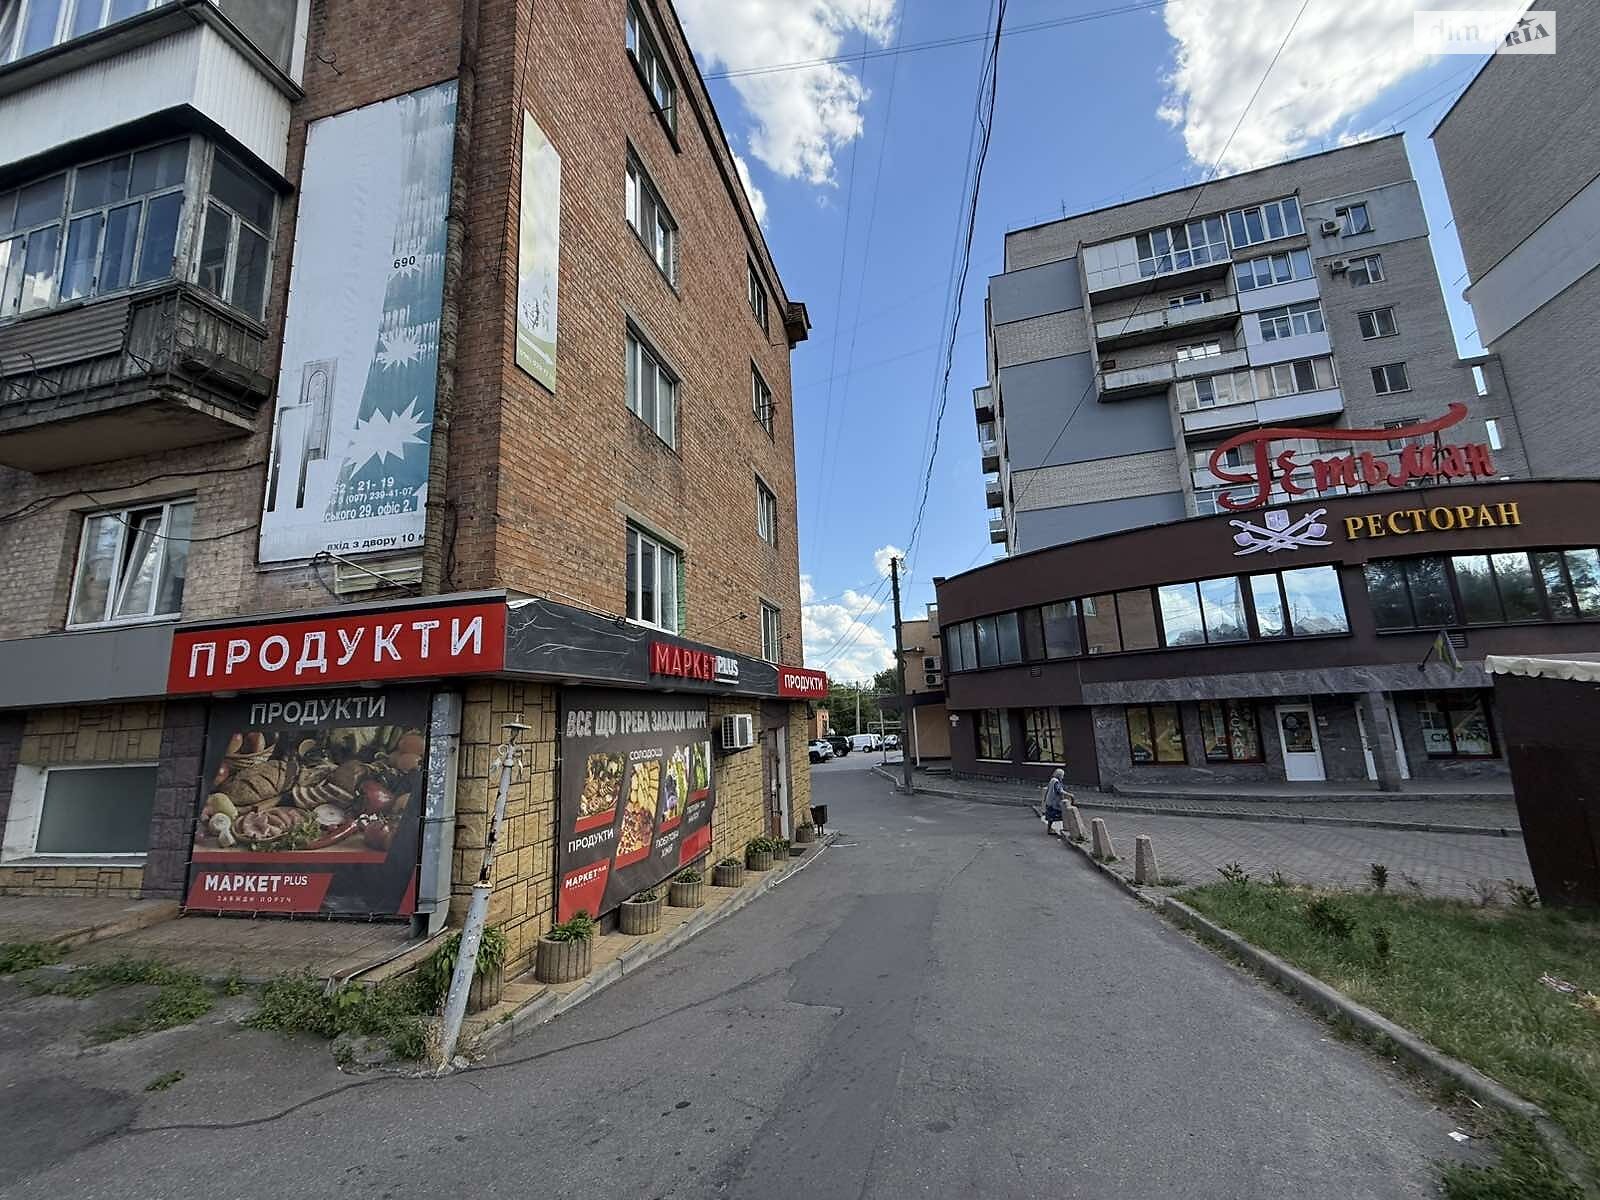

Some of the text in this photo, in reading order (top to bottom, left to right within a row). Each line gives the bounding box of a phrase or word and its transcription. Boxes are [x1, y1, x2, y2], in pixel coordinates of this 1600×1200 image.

[393, 255, 416, 269] 690
[1343, 502, 1522, 540] РЕСТОРАН
[362, 536, 397, 549] двору
[402, 532, 414, 543] 10
[188, 616, 483, 678] ПРОДУКТИ
[653, 643, 739, 682] МАРКЕТ PLUS
[784, 674, 823, 692] ПРОДУКТИ
[249, 695, 387, 726] ПРОДУКТИ
[566, 710, 593, 738] ВСЕ
[595, 710, 617, 738] ЩО
[619, 710, 651, 735] ТРЕБА
[568, 828, 614, 853] ПРОДУКТИ
[204, 874, 308, 893] МАРКЕТ PLUS
[565, 868, 599, 889] МАРКЕТ
